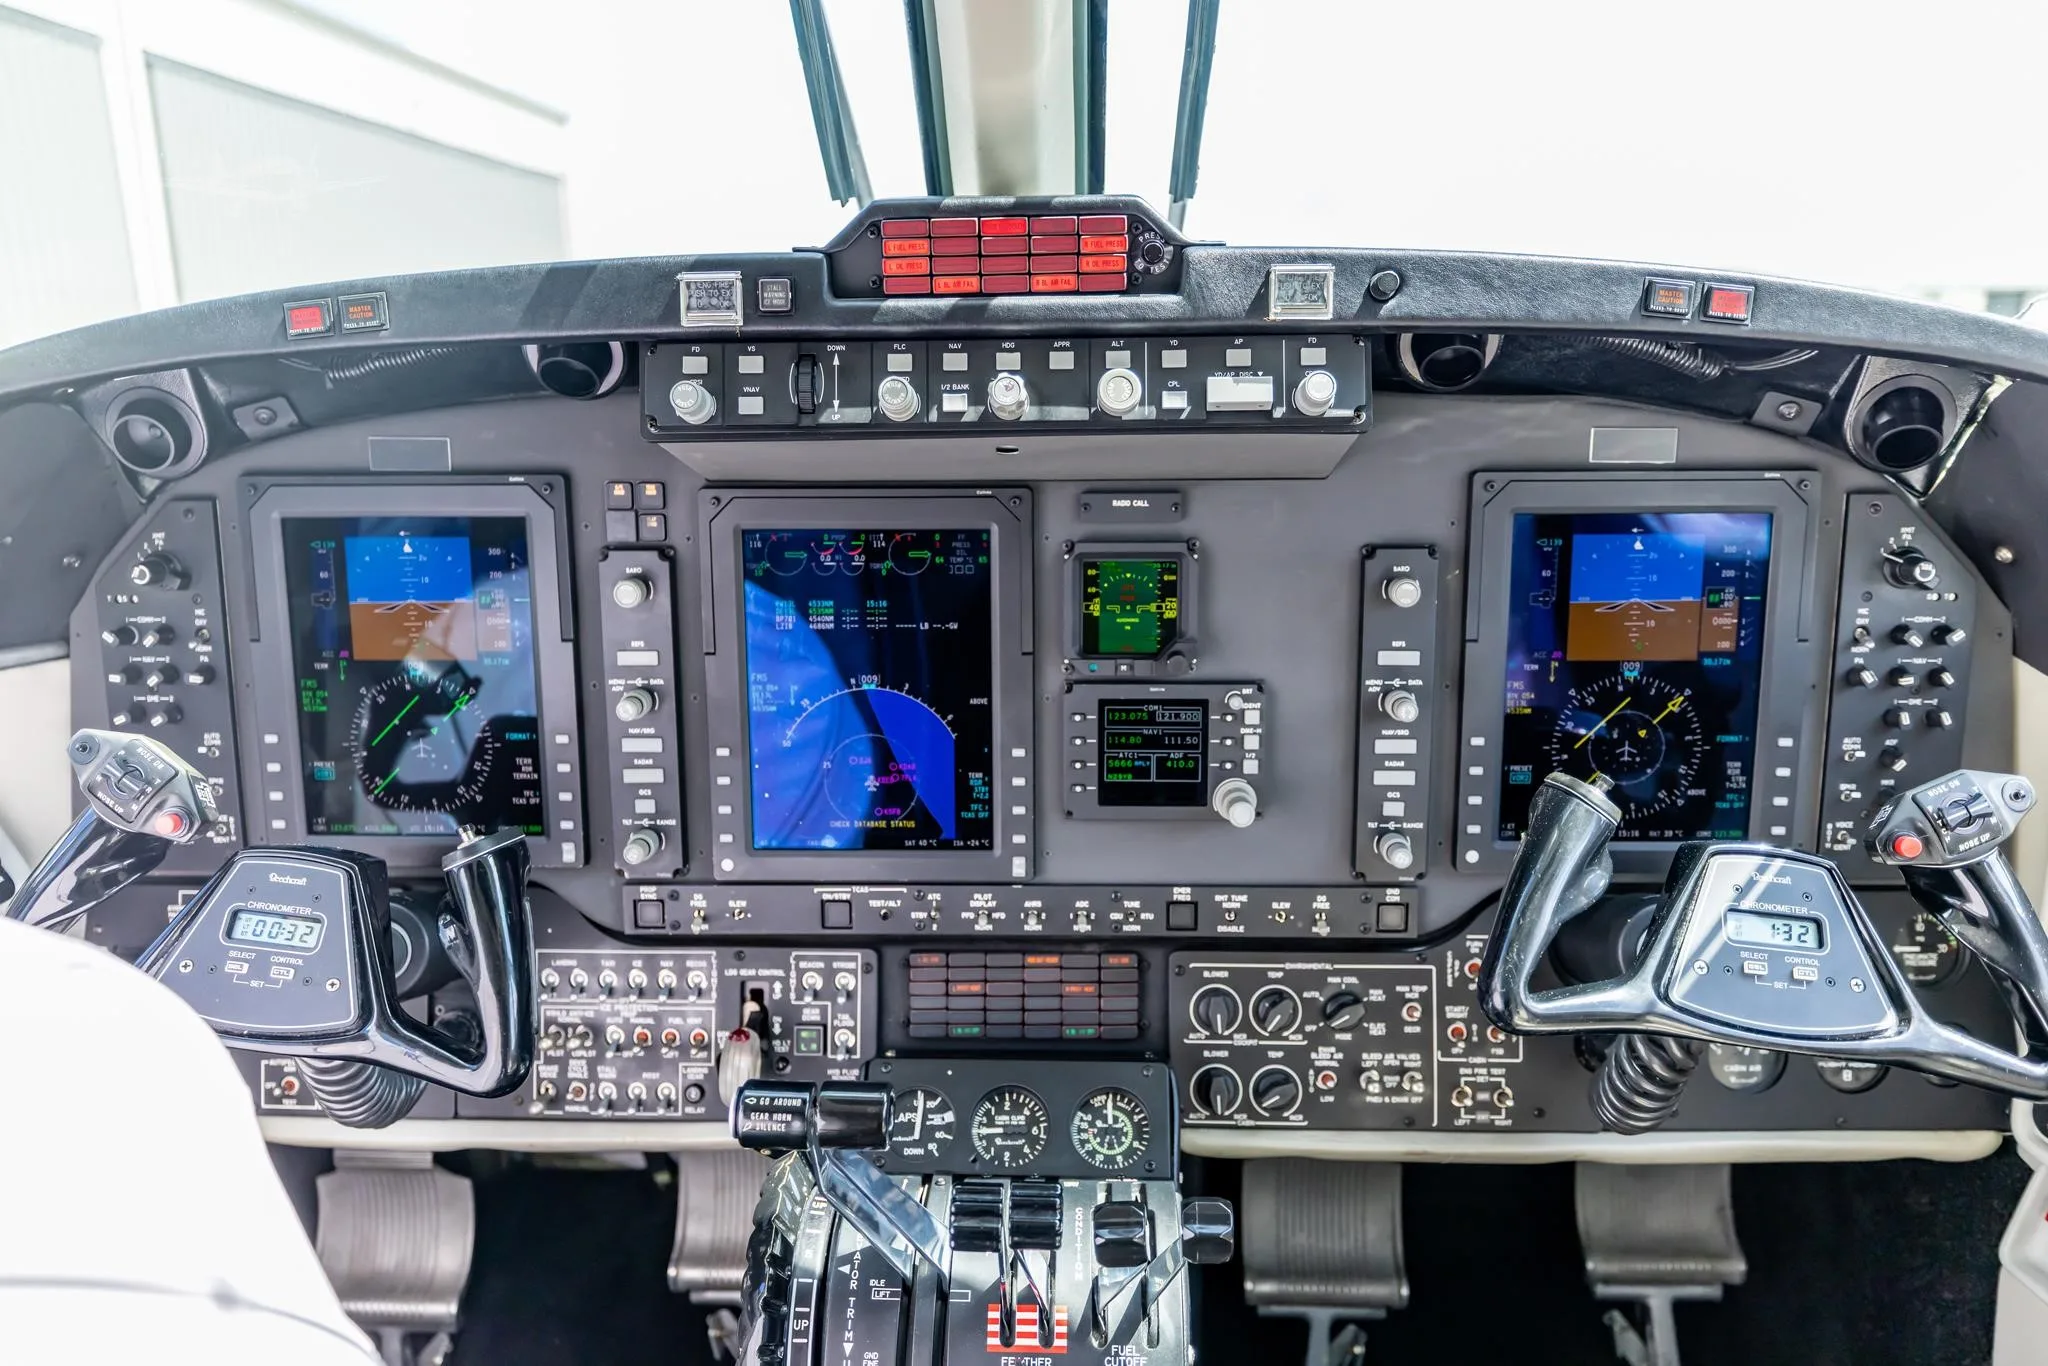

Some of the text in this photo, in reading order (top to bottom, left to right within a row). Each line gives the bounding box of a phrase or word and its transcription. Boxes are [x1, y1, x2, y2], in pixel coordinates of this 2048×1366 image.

[1138, 232, 1166, 243] PRESS
[906, 242, 925, 250] PRESS
[1091, 240, 1103, 248] FUEL
[906, 262, 923, 270] PRESS
[1102, 259, 1120, 267] PRESS
[1150, 258, 1170, 274] TEST
[1109, 712, 1199, 721] 123.075 121.900
[1165, 736, 1198, 744] 111.50
[136, 746, 153, 762] NOSE
[1928, 787, 1949, 796] NOSE
[96, 791, 124, 814] NOSE UP
[1958, 833, 1990, 851] NOSE UP
[247, 901, 312, 915] CHRONOMETER
[1740, 901, 1808, 914] CHRONOMETER
[251, 919, 315, 944] 00:32
[229, 951, 256, 959] SELECT
[1740, 951, 1769, 960] SELECT
[271, 955, 304, 965] CONTROL
[1784, 956, 1820, 966] CONTROL
[250, 980, 264, 988] SET
[1774, 981, 1788, 989] SET
[760, 1098, 801, 1106] GO AROUND
[1004, 1102, 1010, 1110] 2
[751, 1113, 770, 1121] GEAR
[756, 1123, 786, 1132] SILENCE
[904, 1148, 924, 1156] DOWN
[1004, 1152, 1010, 1160] 2
[1075, 1208, 1084, 1280] CONDITION
[844, 1298, 856, 1341] TRIM
[793, 1320, 809, 1330] UP
[1112, 1345, 1138, 1356] FUEL
[1104, 1356, 1147, 1366] CUTOFF
